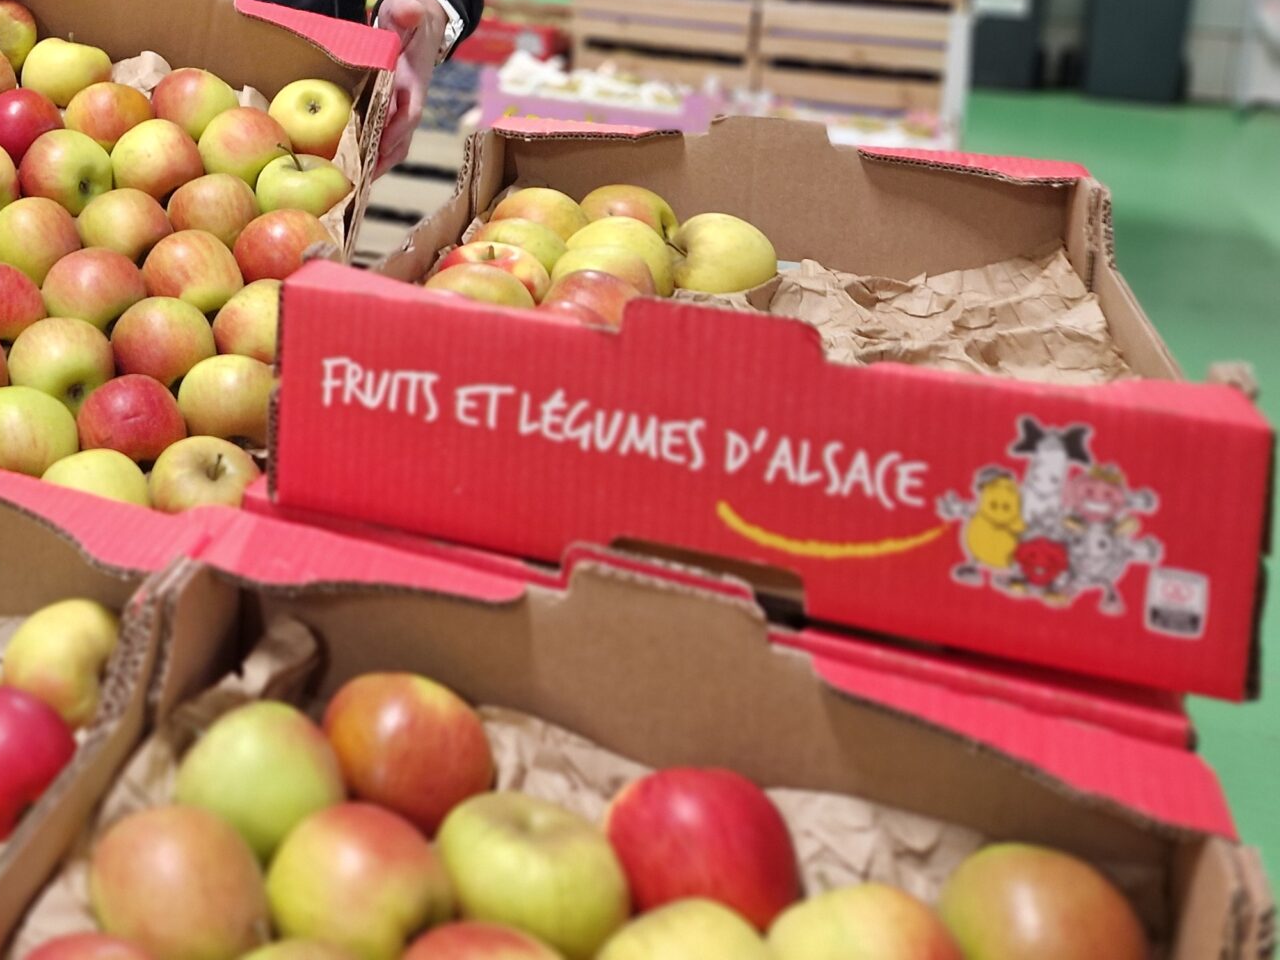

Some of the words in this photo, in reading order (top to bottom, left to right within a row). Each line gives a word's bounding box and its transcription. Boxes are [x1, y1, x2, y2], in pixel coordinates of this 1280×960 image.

[321, 355, 439, 423] FRUITS
[455, 384, 515, 430] ET
[519, 387, 706, 472] LÉGUMES
[724, 428, 929, 511] D'ALSACE
